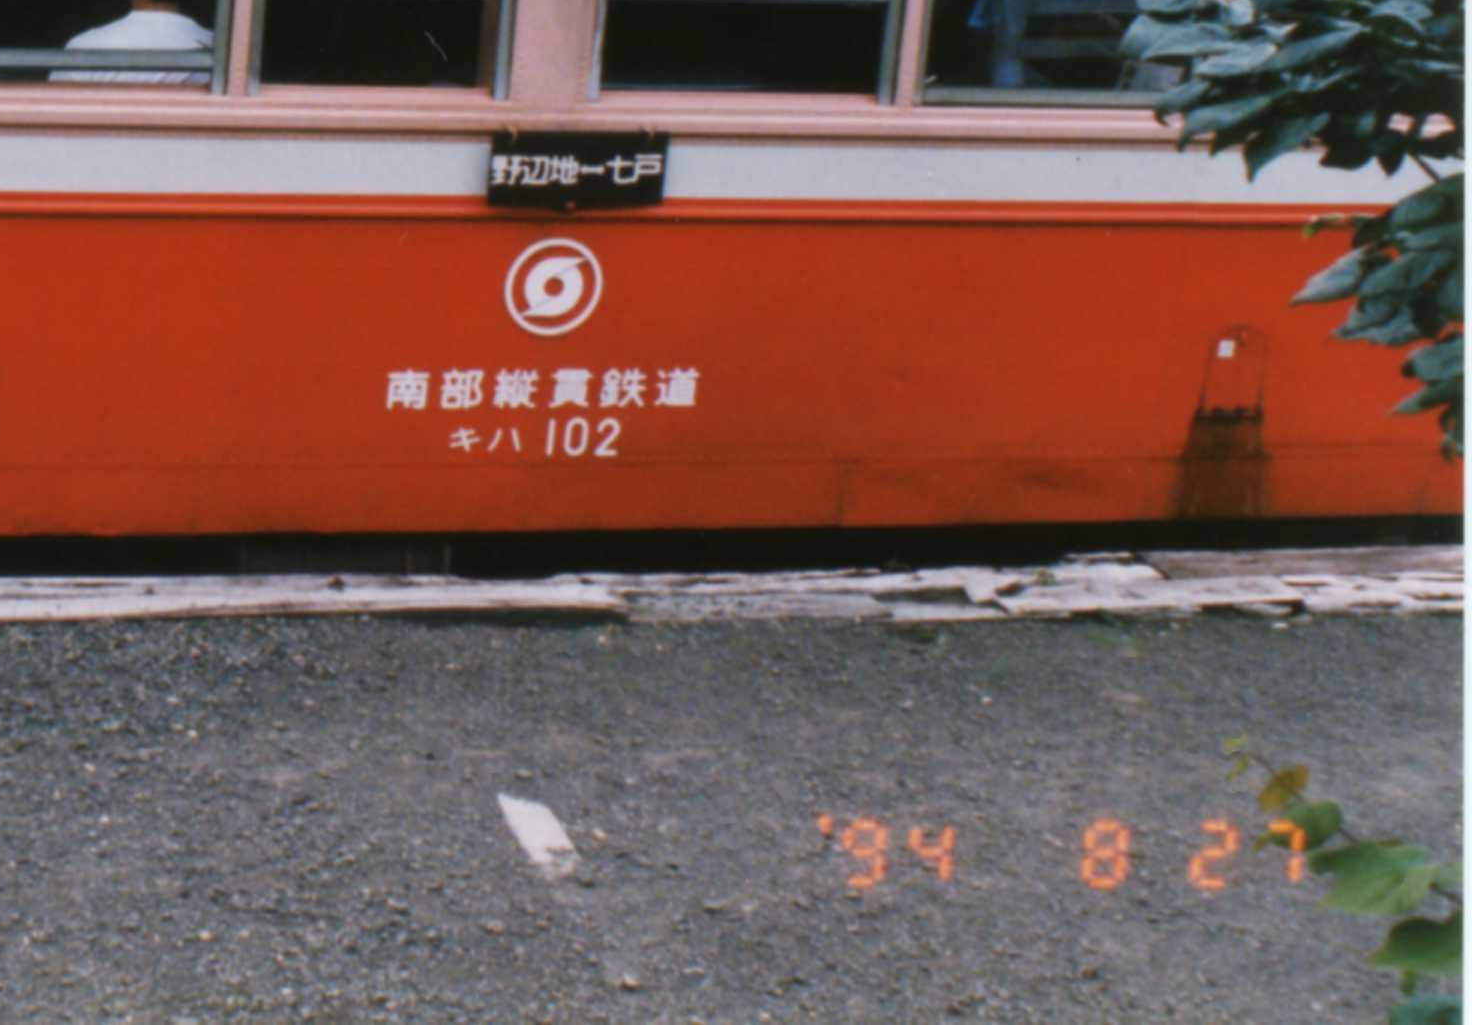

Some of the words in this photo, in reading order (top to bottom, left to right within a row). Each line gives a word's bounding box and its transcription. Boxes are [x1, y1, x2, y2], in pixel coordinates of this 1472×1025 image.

[385, 367, 700, 410] 南部縦貫鉄道
[449, 427, 521, 452] キハ
[545, 416, 622, 457] 102
